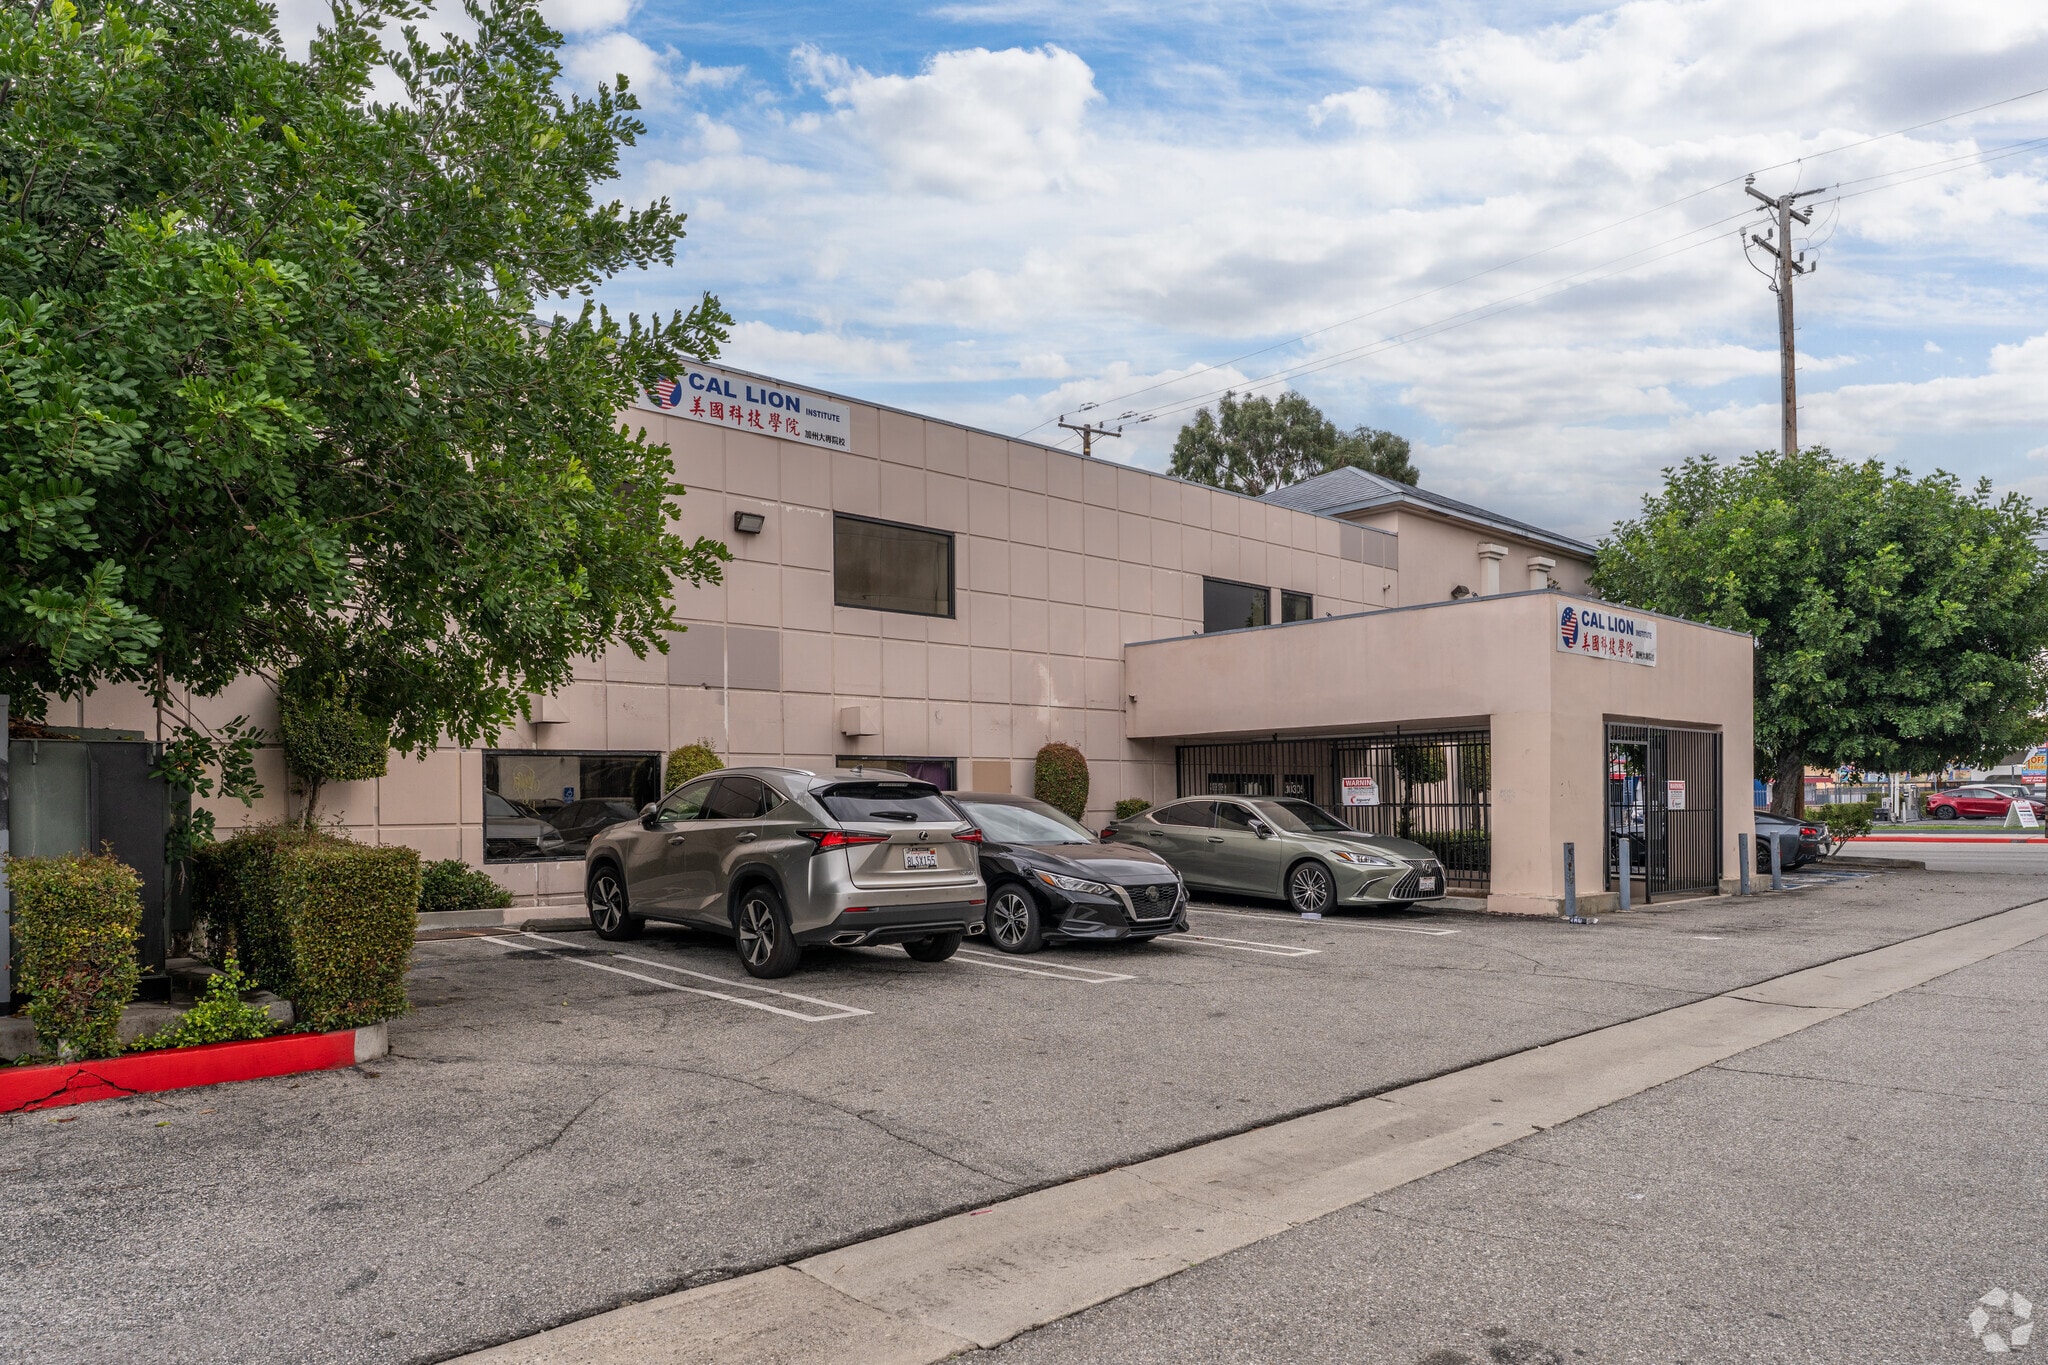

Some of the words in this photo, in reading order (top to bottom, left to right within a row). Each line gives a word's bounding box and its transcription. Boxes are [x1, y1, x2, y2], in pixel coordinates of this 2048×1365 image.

[688, 372, 737, 399] CAL
[746, 385, 801, 414] LION
[805, 407, 841, 423] INSTITUTE
[689, 396, 801, 437] 美國科技學院
[1581, 610, 1605, 630] CAL
[1608, 615, 1634, 636] LION
[2031, 756, 2045, 764] OFF
[1345, 779, 1372, 787] WARNIN
[906, 855, 936, 866] 8LSX155
